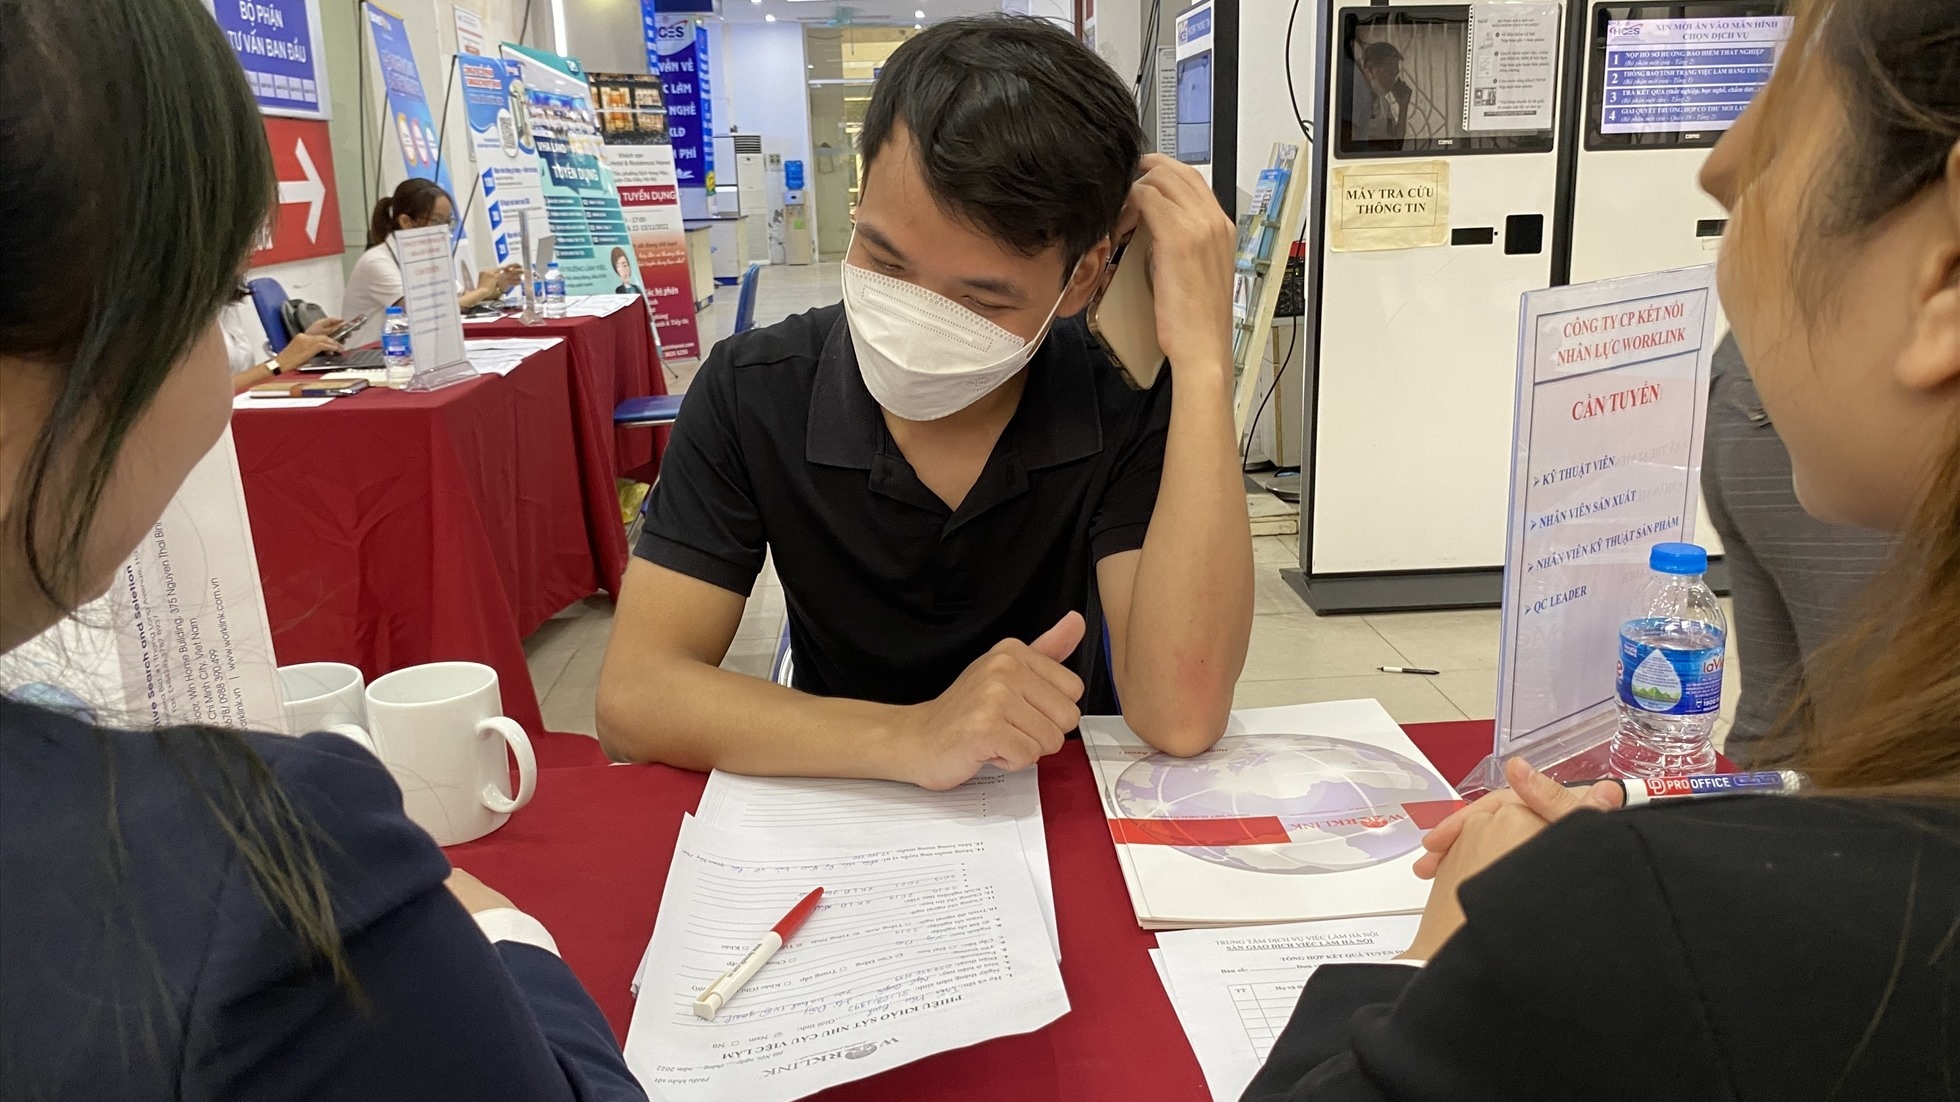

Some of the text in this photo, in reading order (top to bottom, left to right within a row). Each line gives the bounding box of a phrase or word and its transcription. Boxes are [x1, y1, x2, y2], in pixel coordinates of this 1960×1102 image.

[256, 4, 283, 31] PHẬN
[1674, 22, 1692, 30] MỜI
[1710, 21, 1729, 29] VÀO
[1755, 20, 1778, 28] HÌNH
[1682, 32, 1749, 41] CHỌN DỊCH VỤ
[265, 39, 287, 59] BAN
[1613, 54, 1619, 65] 1
[1625, 52, 1640, 60] NỘP
[671, 82, 692, 95] LÀM
[1611, 73, 1618, 84] 2
[1610, 92, 1617, 102] 3
[1609, 110, 1616, 121] 4
[679, 147, 697, 159] PHÍ
[621, 189, 678, 203] TUYỂN DỤNG
[1346, 186, 1434, 200] MÁY TRA CỨU
[1356, 202, 1426, 214] THÔNG TIN
[1564, 300, 1684, 338] CÔNG TY CP KẾT NỐI
[1557, 326, 1686, 366] NHÂN LỰC WORKLINK
[1571, 381, 1660, 421] CẦN TUYỂN
[1542, 454, 1616, 486] KỸ THUẬT VIÊN
[1540, 489, 1636, 529] NHÂN VIÊN SẢN XUẤT
[158, 540, 168, 560] Thai
[1536, 515, 1680, 571] NHÂN VIÊN KỸ THUẬT SẢN PHẨM
[162, 559, 177, 597] Nguyen
[168, 597, 180, 615] 375
[1534, 586, 1588, 614] QC LEADER
[126, 565, 155, 699] Search and Seletion
[211, 577, 236, 672] www.worklink.com.vn
[174, 616, 188, 654] Building,
[183, 654, 193, 683] Home
[190, 617, 217, 720] Chi Minh City, Viet Nam
[210, 648, 227, 705] 0988 390 499
[1266, 936, 1290, 944] DỊCH
[1290, 936, 1304, 944] VỤ
[1304, 934, 1326, 942] VIỆC
[1348, 932, 1361, 940] HÀ
[1362, 930, 1380, 938] NỘI
[1271, 942, 1294, 950] DỊCH
[1357, 938, 1375, 946] NỘI
[1306, 954, 1325, 962] HỢP
[722, 994, 962, 1060] PHIẾU KHẢO SÁT NHU CẦU VIỆC LÀM
[748, 1034, 768, 1042] Nam
